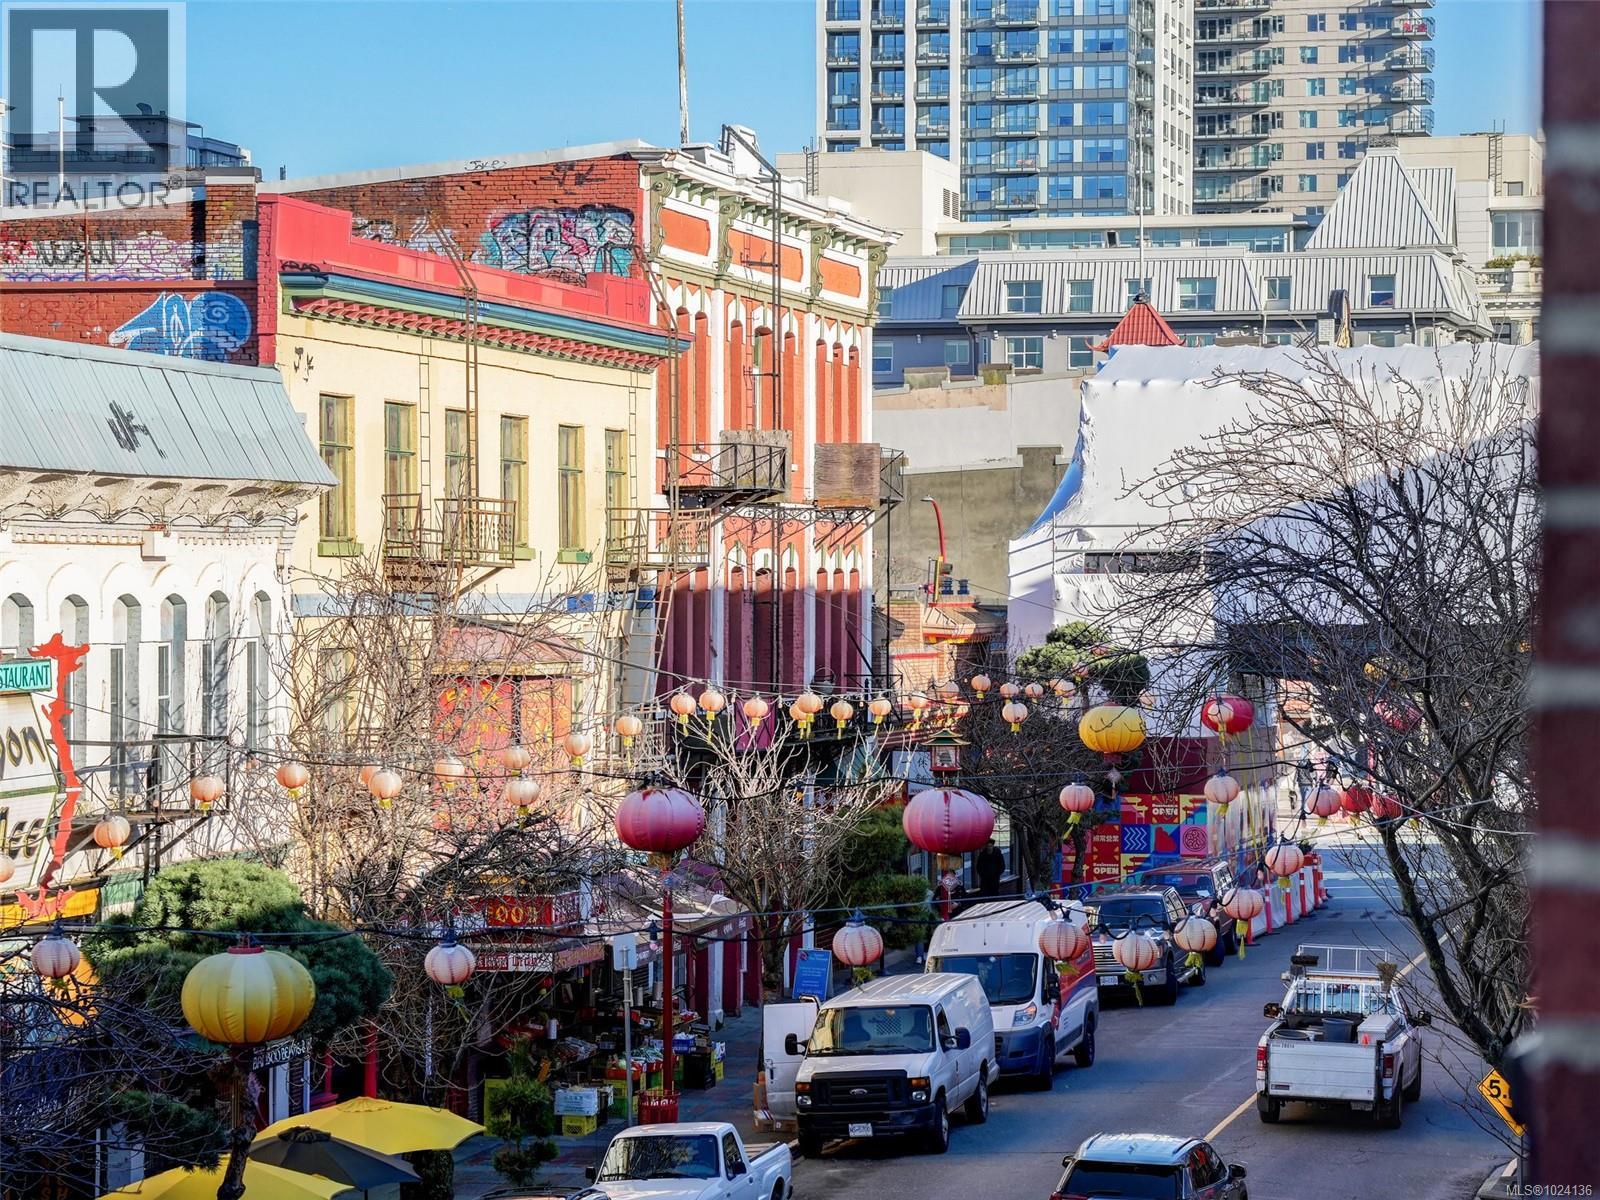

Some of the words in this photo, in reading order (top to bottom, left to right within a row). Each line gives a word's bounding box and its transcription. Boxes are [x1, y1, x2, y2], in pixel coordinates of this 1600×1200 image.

[0, 726, 46, 768] on
[1152, 808, 1178, 816] OPEN
[1093, 867, 1119, 875] OPEN
[1489, 1079, 1511, 1099] 5.
